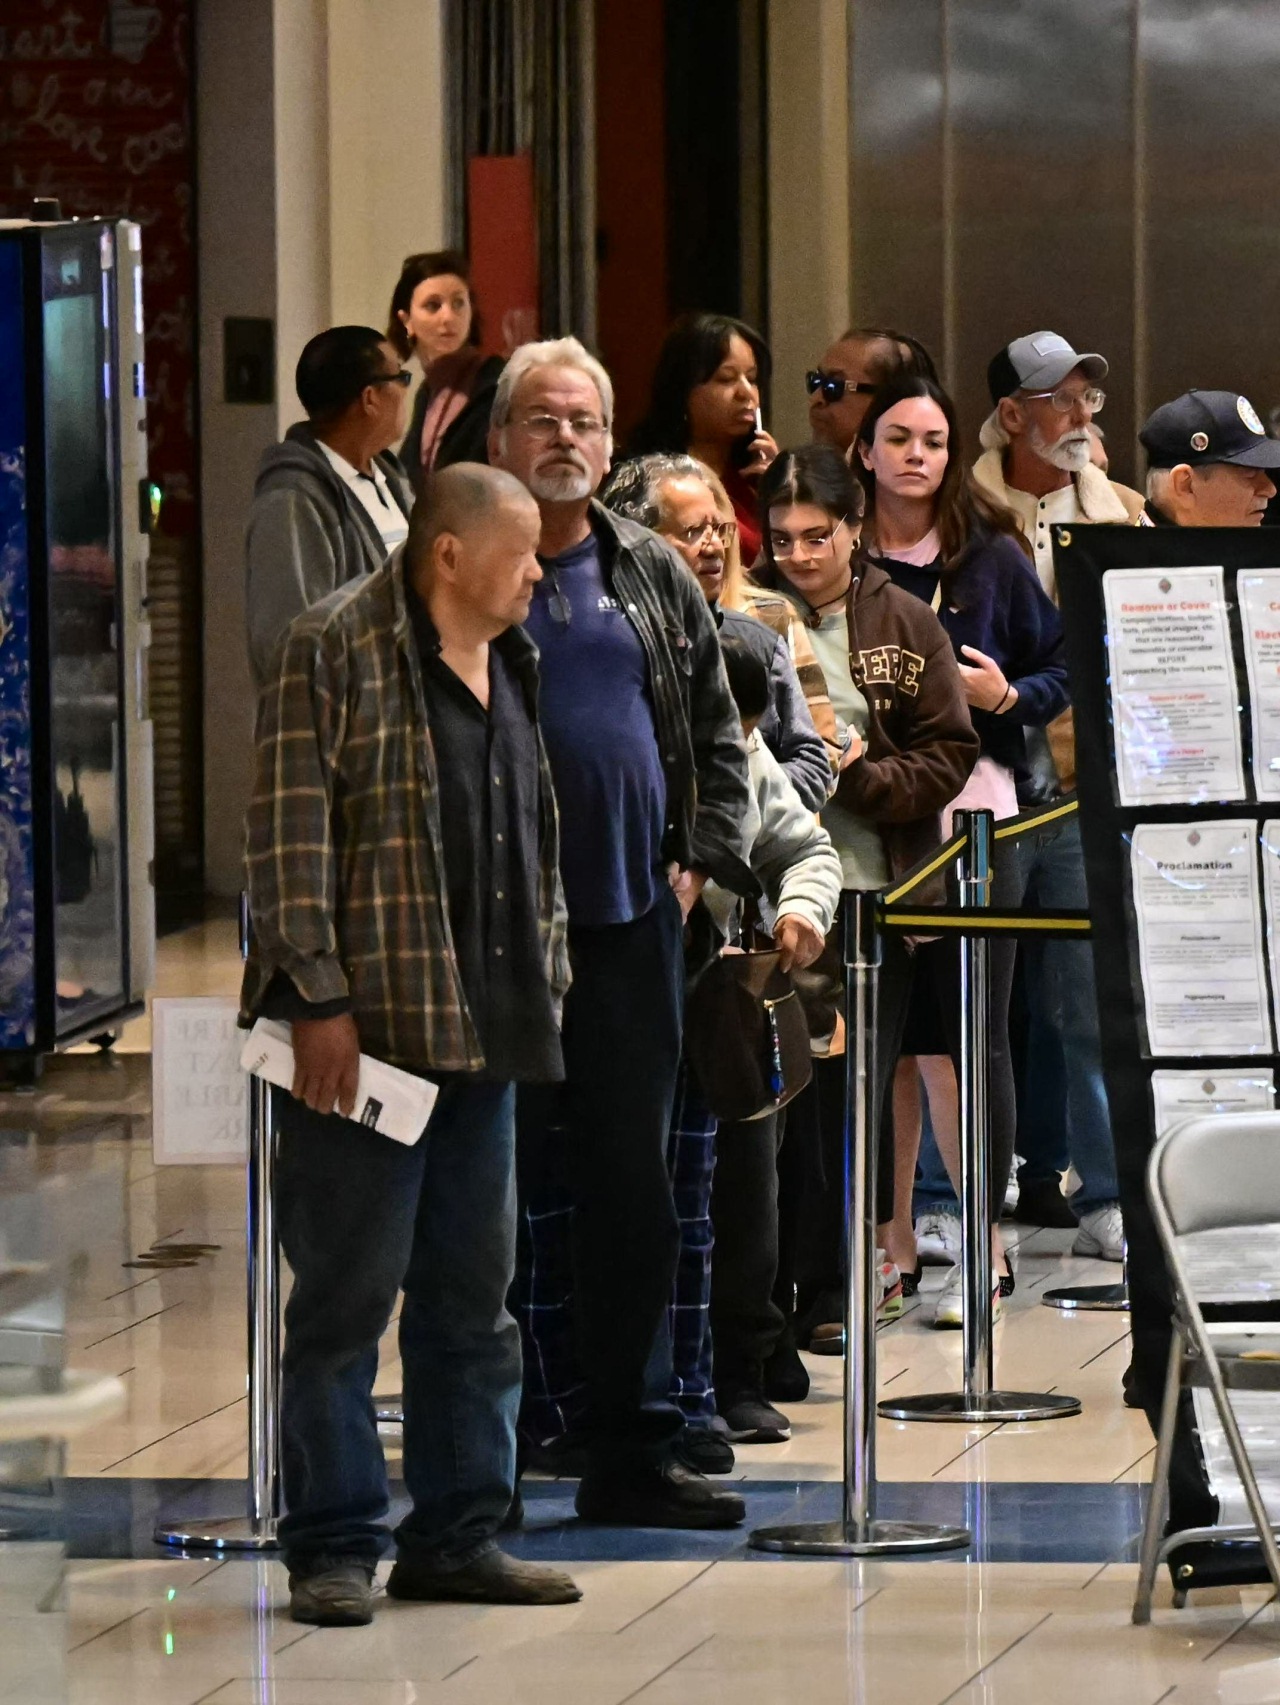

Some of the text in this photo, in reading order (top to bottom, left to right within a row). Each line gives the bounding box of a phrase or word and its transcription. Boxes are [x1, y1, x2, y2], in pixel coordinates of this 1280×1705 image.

[1166, 603, 1177, 611] or
[1180, 601, 1211, 610] Cover
[1157, 861, 1233, 871] Proclamation
